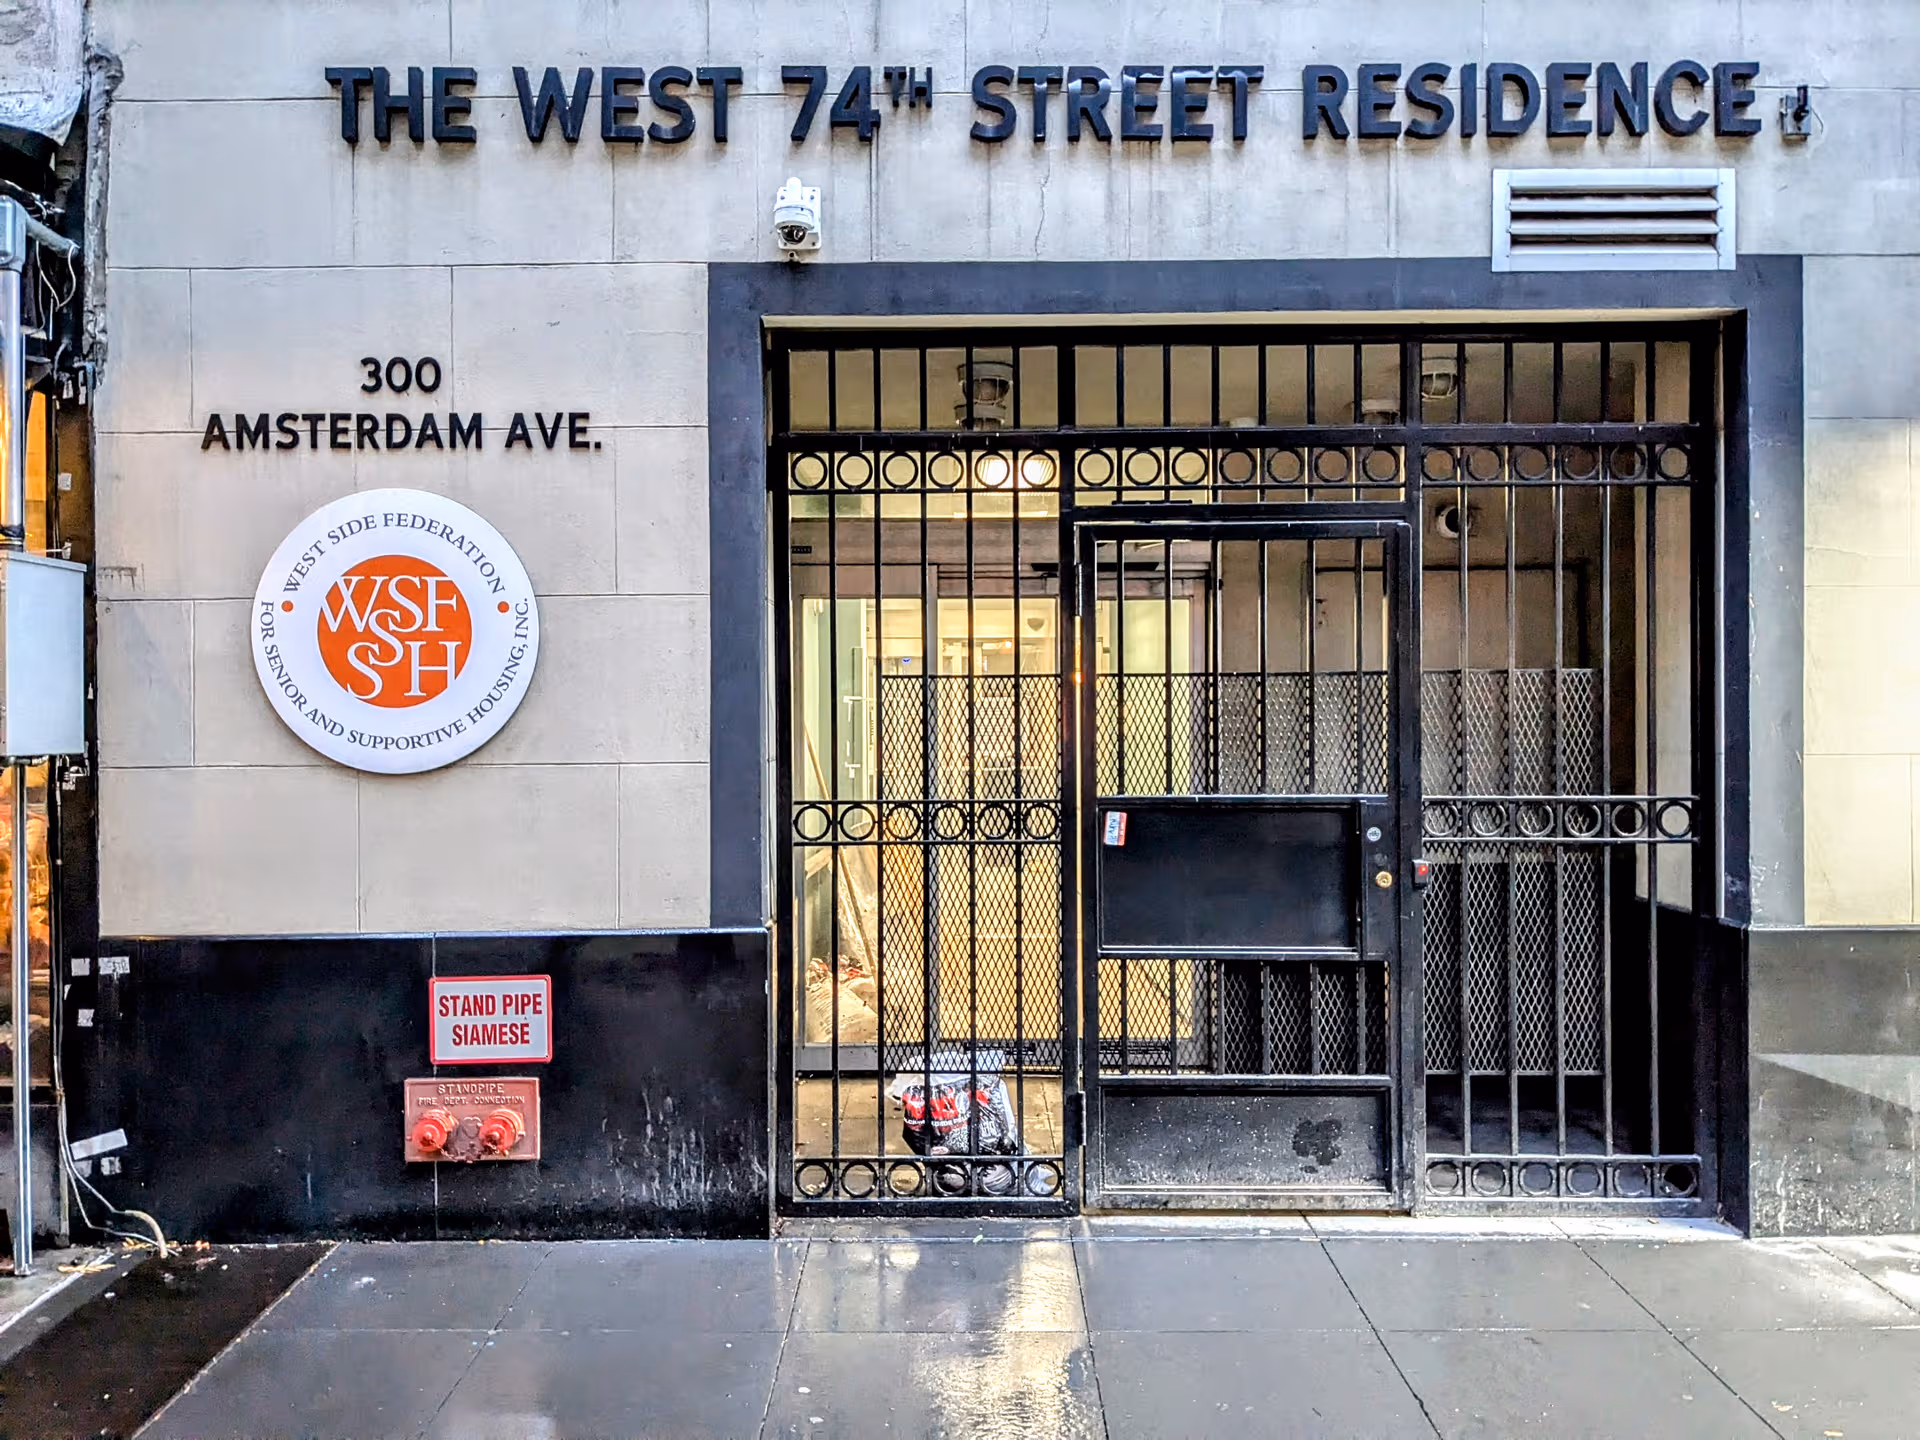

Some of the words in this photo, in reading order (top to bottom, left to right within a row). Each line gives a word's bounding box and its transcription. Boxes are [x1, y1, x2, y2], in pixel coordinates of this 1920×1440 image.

[324, 65, 478, 143] THE
[511, 65, 744, 143] WEST
[780, 65, 933, 143] 74TH
[969, 64, 1265, 143] STREET
[1302, 60, 1762, 141] RESIDENCE
[360, 356, 442, 393] 300
[201, 412, 483, 450] AMSTERDAM
[504, 412, 602, 450] AVE.
[283, 539, 326, 594] WEST
[327, 514, 378, 546] SIDE
[383, 512, 506, 595] FEDERATION
[260, 600, 275, 642] FOR
[514, 597, 529, 640] INC.
[264, 644, 308, 713] SENIOR
[466, 643, 529, 726] HOUSING,
[303, 707, 345, 737] AND
[347, 718, 468, 751] SUPPORTIVE
[438, 994, 496, 1018] STAND
[502, 993, 543, 1016] PIPE
[452, 1022, 530, 1047] SIAMESE
[417, 1097, 438, 1106] FIRE
[444, 1096, 469, 1105] DEPT.
[437, 1083, 505, 1095] STANDPIPE
